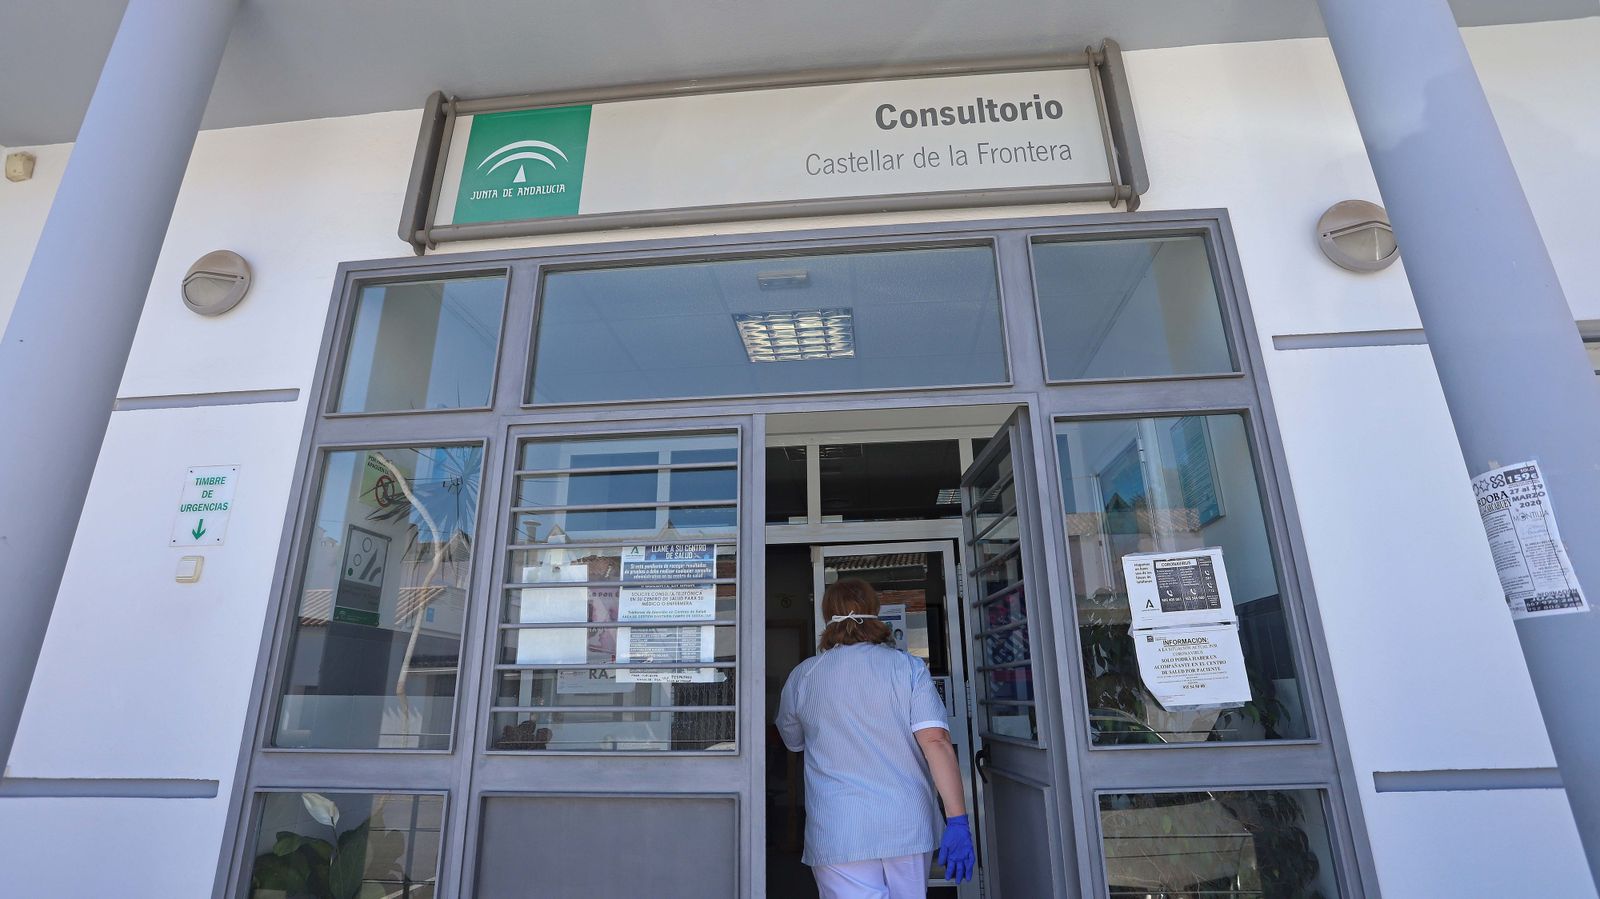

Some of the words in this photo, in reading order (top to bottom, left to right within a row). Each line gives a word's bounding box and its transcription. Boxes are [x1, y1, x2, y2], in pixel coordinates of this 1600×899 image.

[875, 94, 1064, 130] Consultorio
[805, 149, 905, 176] Castellar
[913, 146, 940, 169] de
[949, 145, 969, 167] la
[977, 141, 1073, 165] Frontera
[470, 189, 498, 200] JUNTA
[503, 188, 513, 197] DE
[517, 184, 566, 196] ANDALUCIA
[195, 476, 227, 486] TIMBRE
[1507, 472, 1538, 484] 159€
[202, 490, 213, 498] DE
[1511, 492, 1545, 502] MARZO
[180, 502, 228, 512] URGENCIAS
[1520, 500, 1542, 508] 2020
